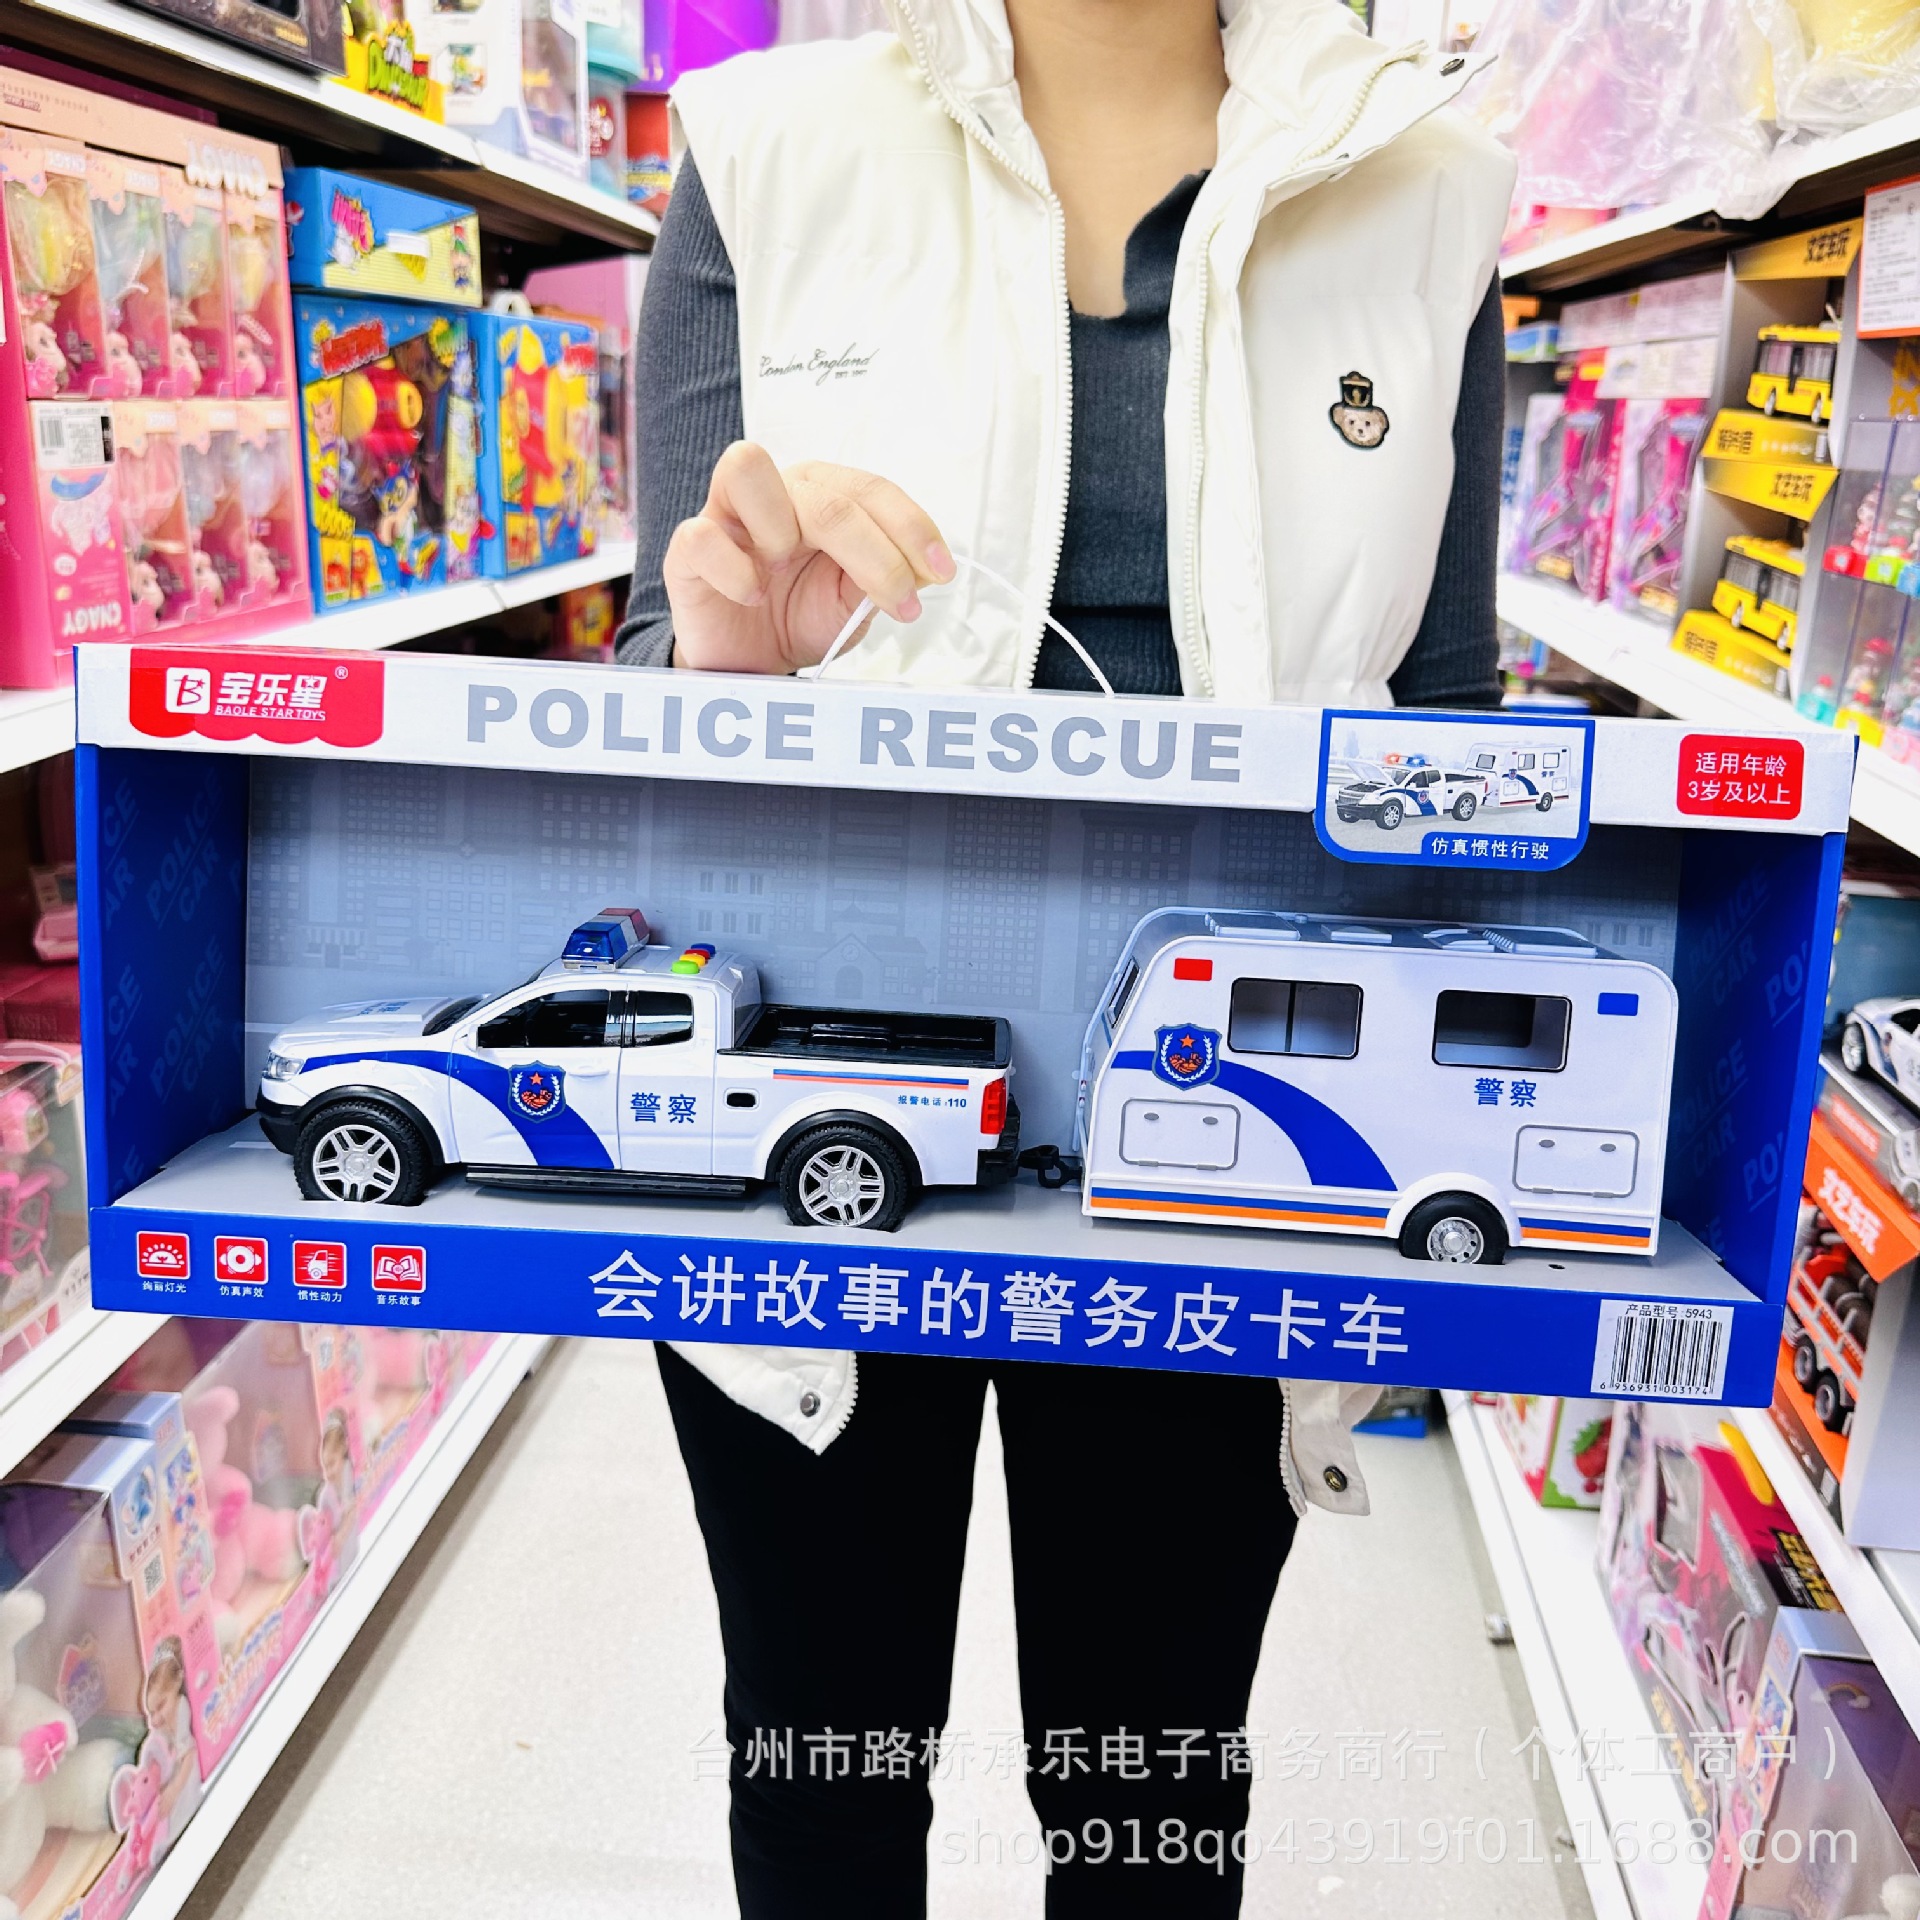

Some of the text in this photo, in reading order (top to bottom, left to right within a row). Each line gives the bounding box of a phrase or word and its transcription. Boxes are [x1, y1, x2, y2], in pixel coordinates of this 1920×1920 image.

[216, 671, 328, 709] 宝乐星
[214, 704, 326, 721] BAOLE STAR TOYS
[466, 683, 1244, 783] POLICE RESCUE
[1695, 751, 1787, 777] 适用年龄
[1687, 780, 1791, 805] 3岁及以上
[1431, 836, 1550, 860] 仿真惯性行驶
[1473, 1077, 1537, 1108] 警察
[629, 1091, 698, 1125] 警察
[142, 1280, 187, 1294] 绚丽灯光
[219, 1284, 265, 1298] 仿真声效
[297, 1289, 343, 1303] 惯性动力
[376, 1293, 422, 1307] 音乐故事
[588, 1247, 1411, 1367] 会讲故事的警务皮卡车
